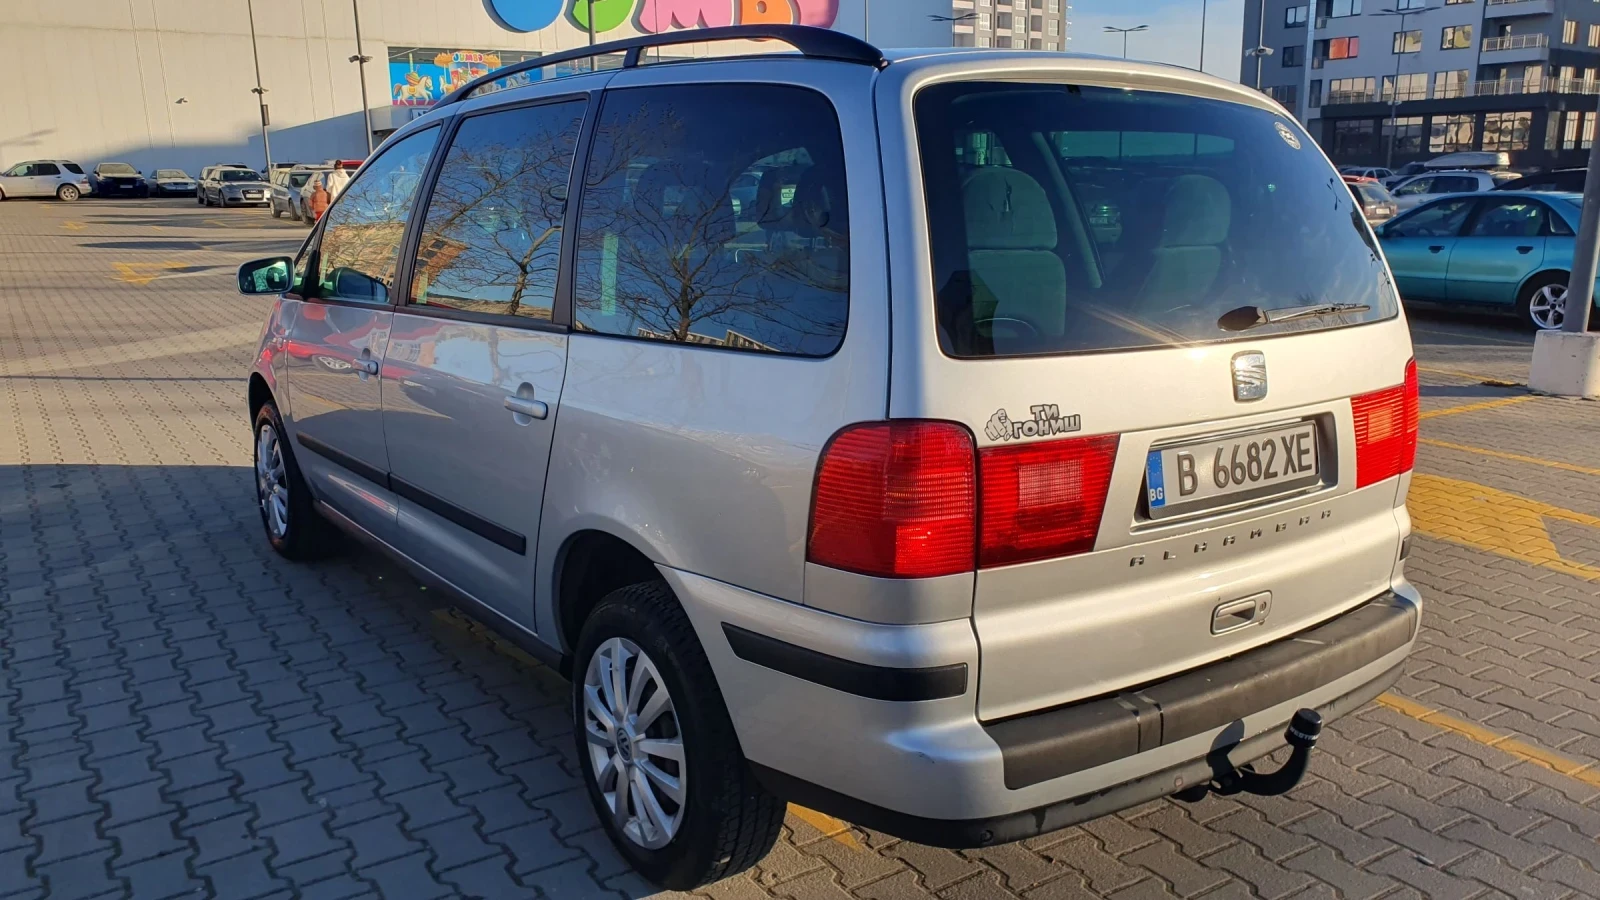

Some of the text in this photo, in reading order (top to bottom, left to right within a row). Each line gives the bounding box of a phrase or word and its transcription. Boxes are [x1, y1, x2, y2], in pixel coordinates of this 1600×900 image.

[1030, 404, 1060, 421] ТИ
[1012, 414, 1081, 439] ГОНИШ
[1177, 431, 1312, 496] B 6682 XE
[1150, 487, 1163, 501] BG
[1129, 509, 1332, 567] ALHAMBRA
